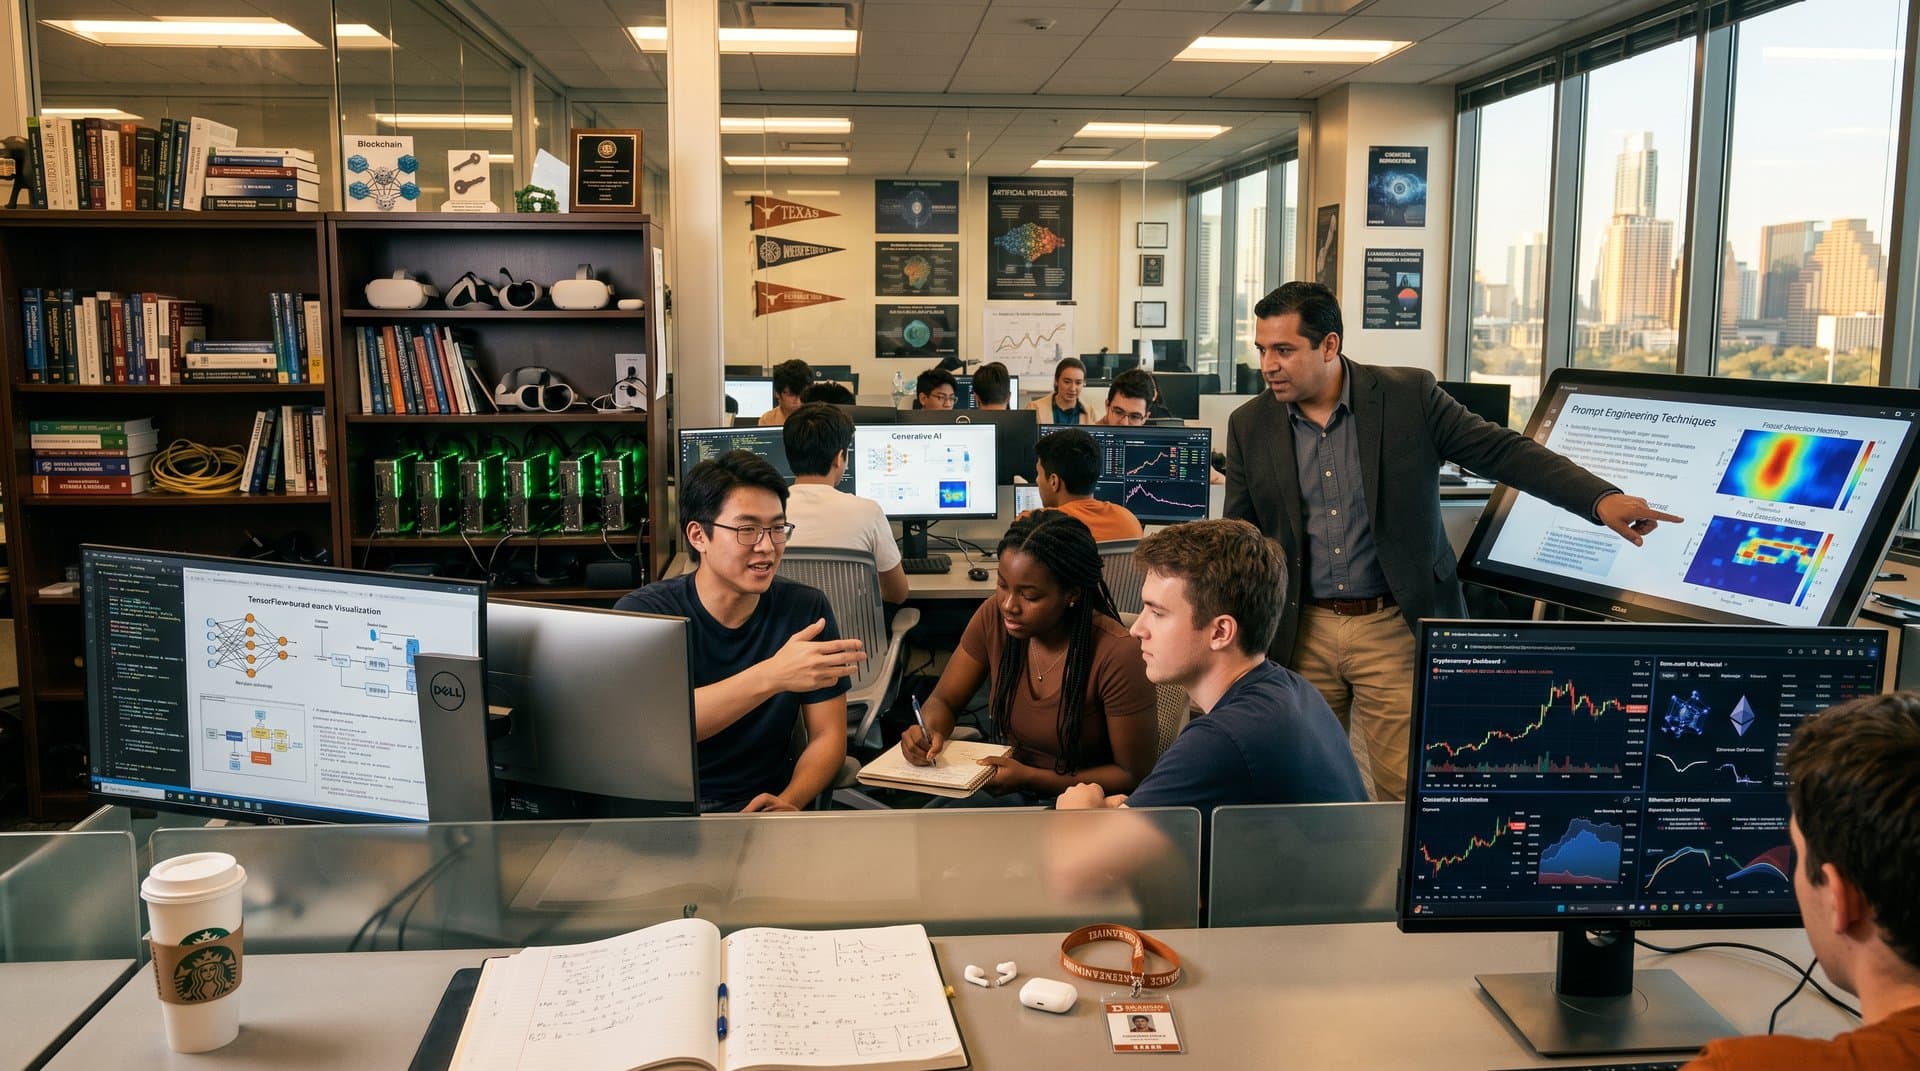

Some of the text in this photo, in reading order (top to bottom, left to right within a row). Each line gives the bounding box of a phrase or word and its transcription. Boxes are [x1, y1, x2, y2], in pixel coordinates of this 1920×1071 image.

[357, 140, 403, 149] Blockchain
[780, 205, 819, 220] TEXAS
[1571, 405, 1717, 428] Prompt Engineering Techniques
[334, 604, 382, 616] Visualization
[433, 685, 462, 698] DELL
